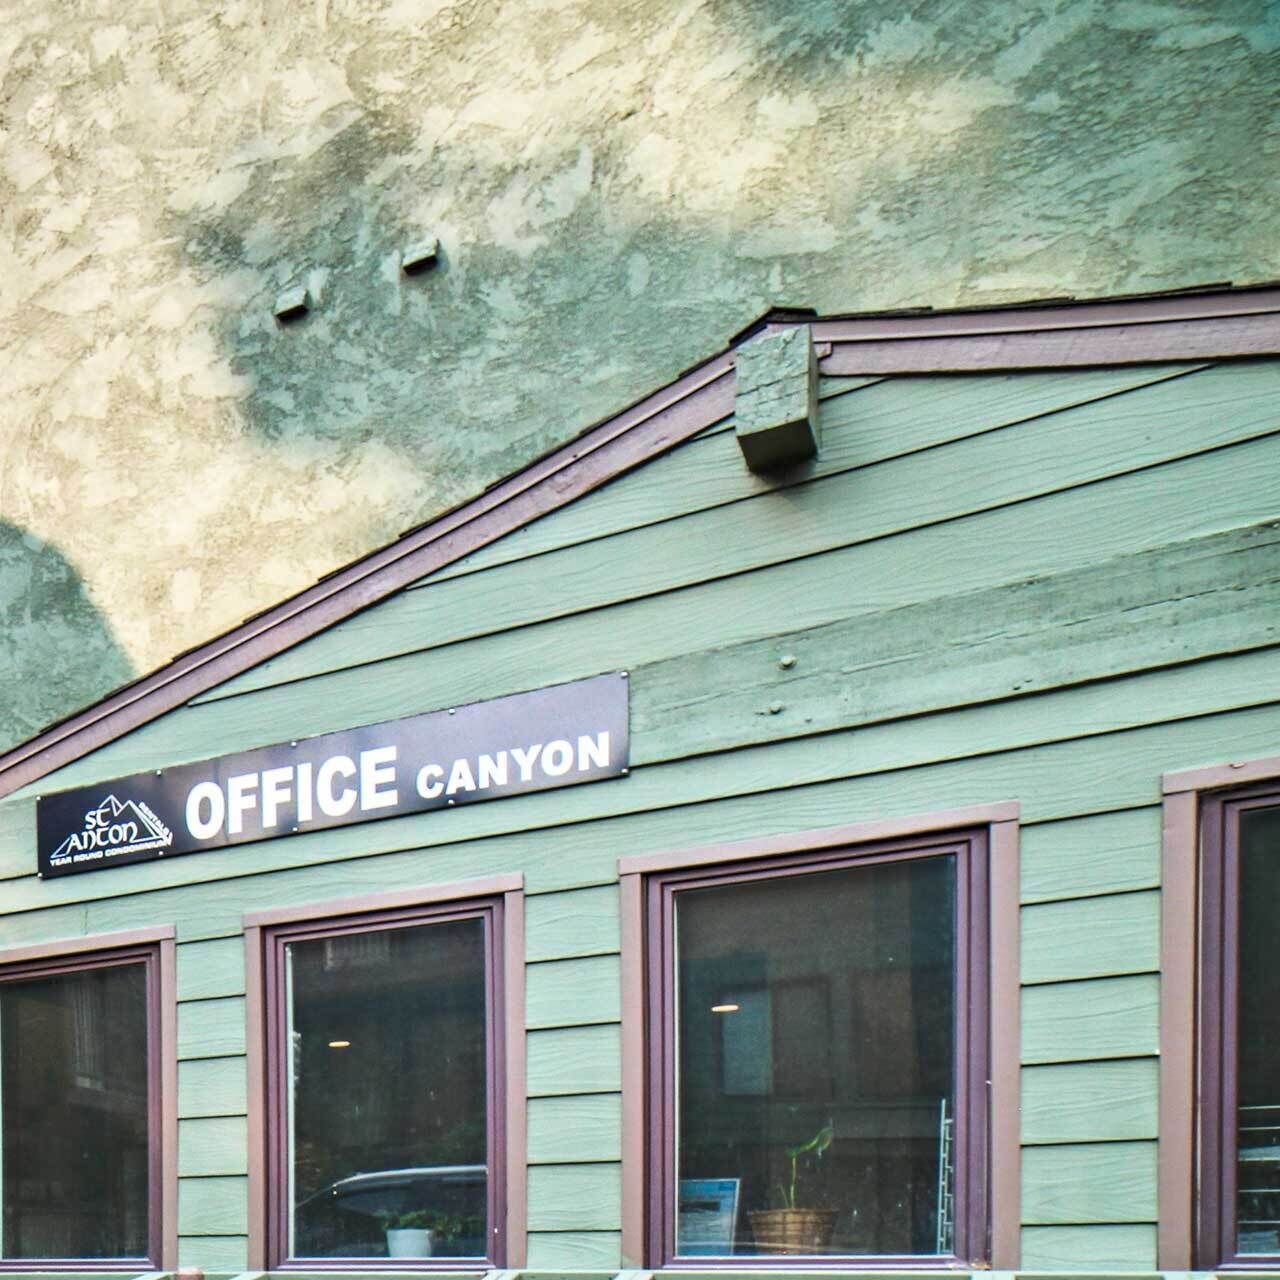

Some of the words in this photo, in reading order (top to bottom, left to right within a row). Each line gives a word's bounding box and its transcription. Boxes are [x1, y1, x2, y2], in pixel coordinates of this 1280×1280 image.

[184, 745, 399, 841] OFFICE
[415, 731, 612, 799] CANYON
[49, 857, 72, 867] YEAR
[73, 850, 104, 863] ROUND
